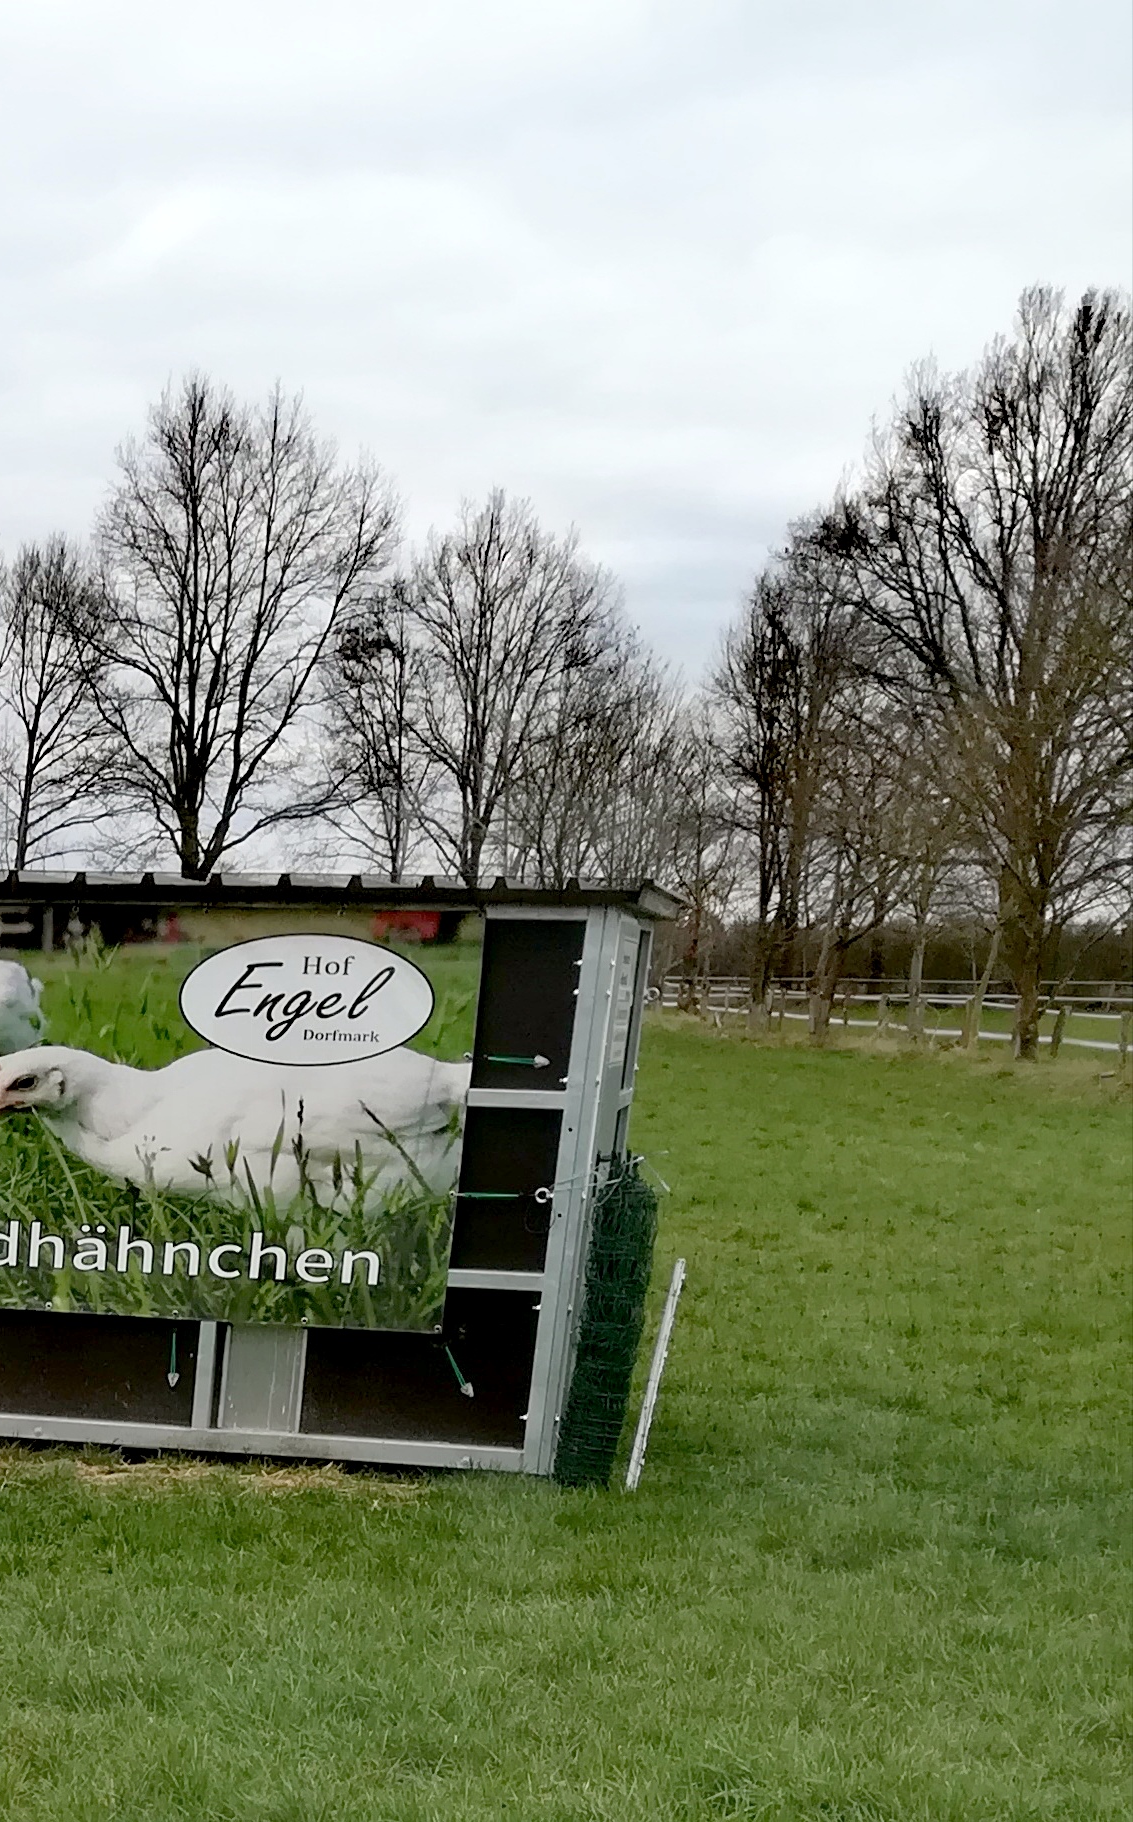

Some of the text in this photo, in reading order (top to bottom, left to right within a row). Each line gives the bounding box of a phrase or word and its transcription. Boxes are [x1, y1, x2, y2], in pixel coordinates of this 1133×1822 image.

[302, 956, 355, 976] Hof
[214, 962, 395, 1041] Engel
[302, 1029, 380, 1043] Dorfmark
